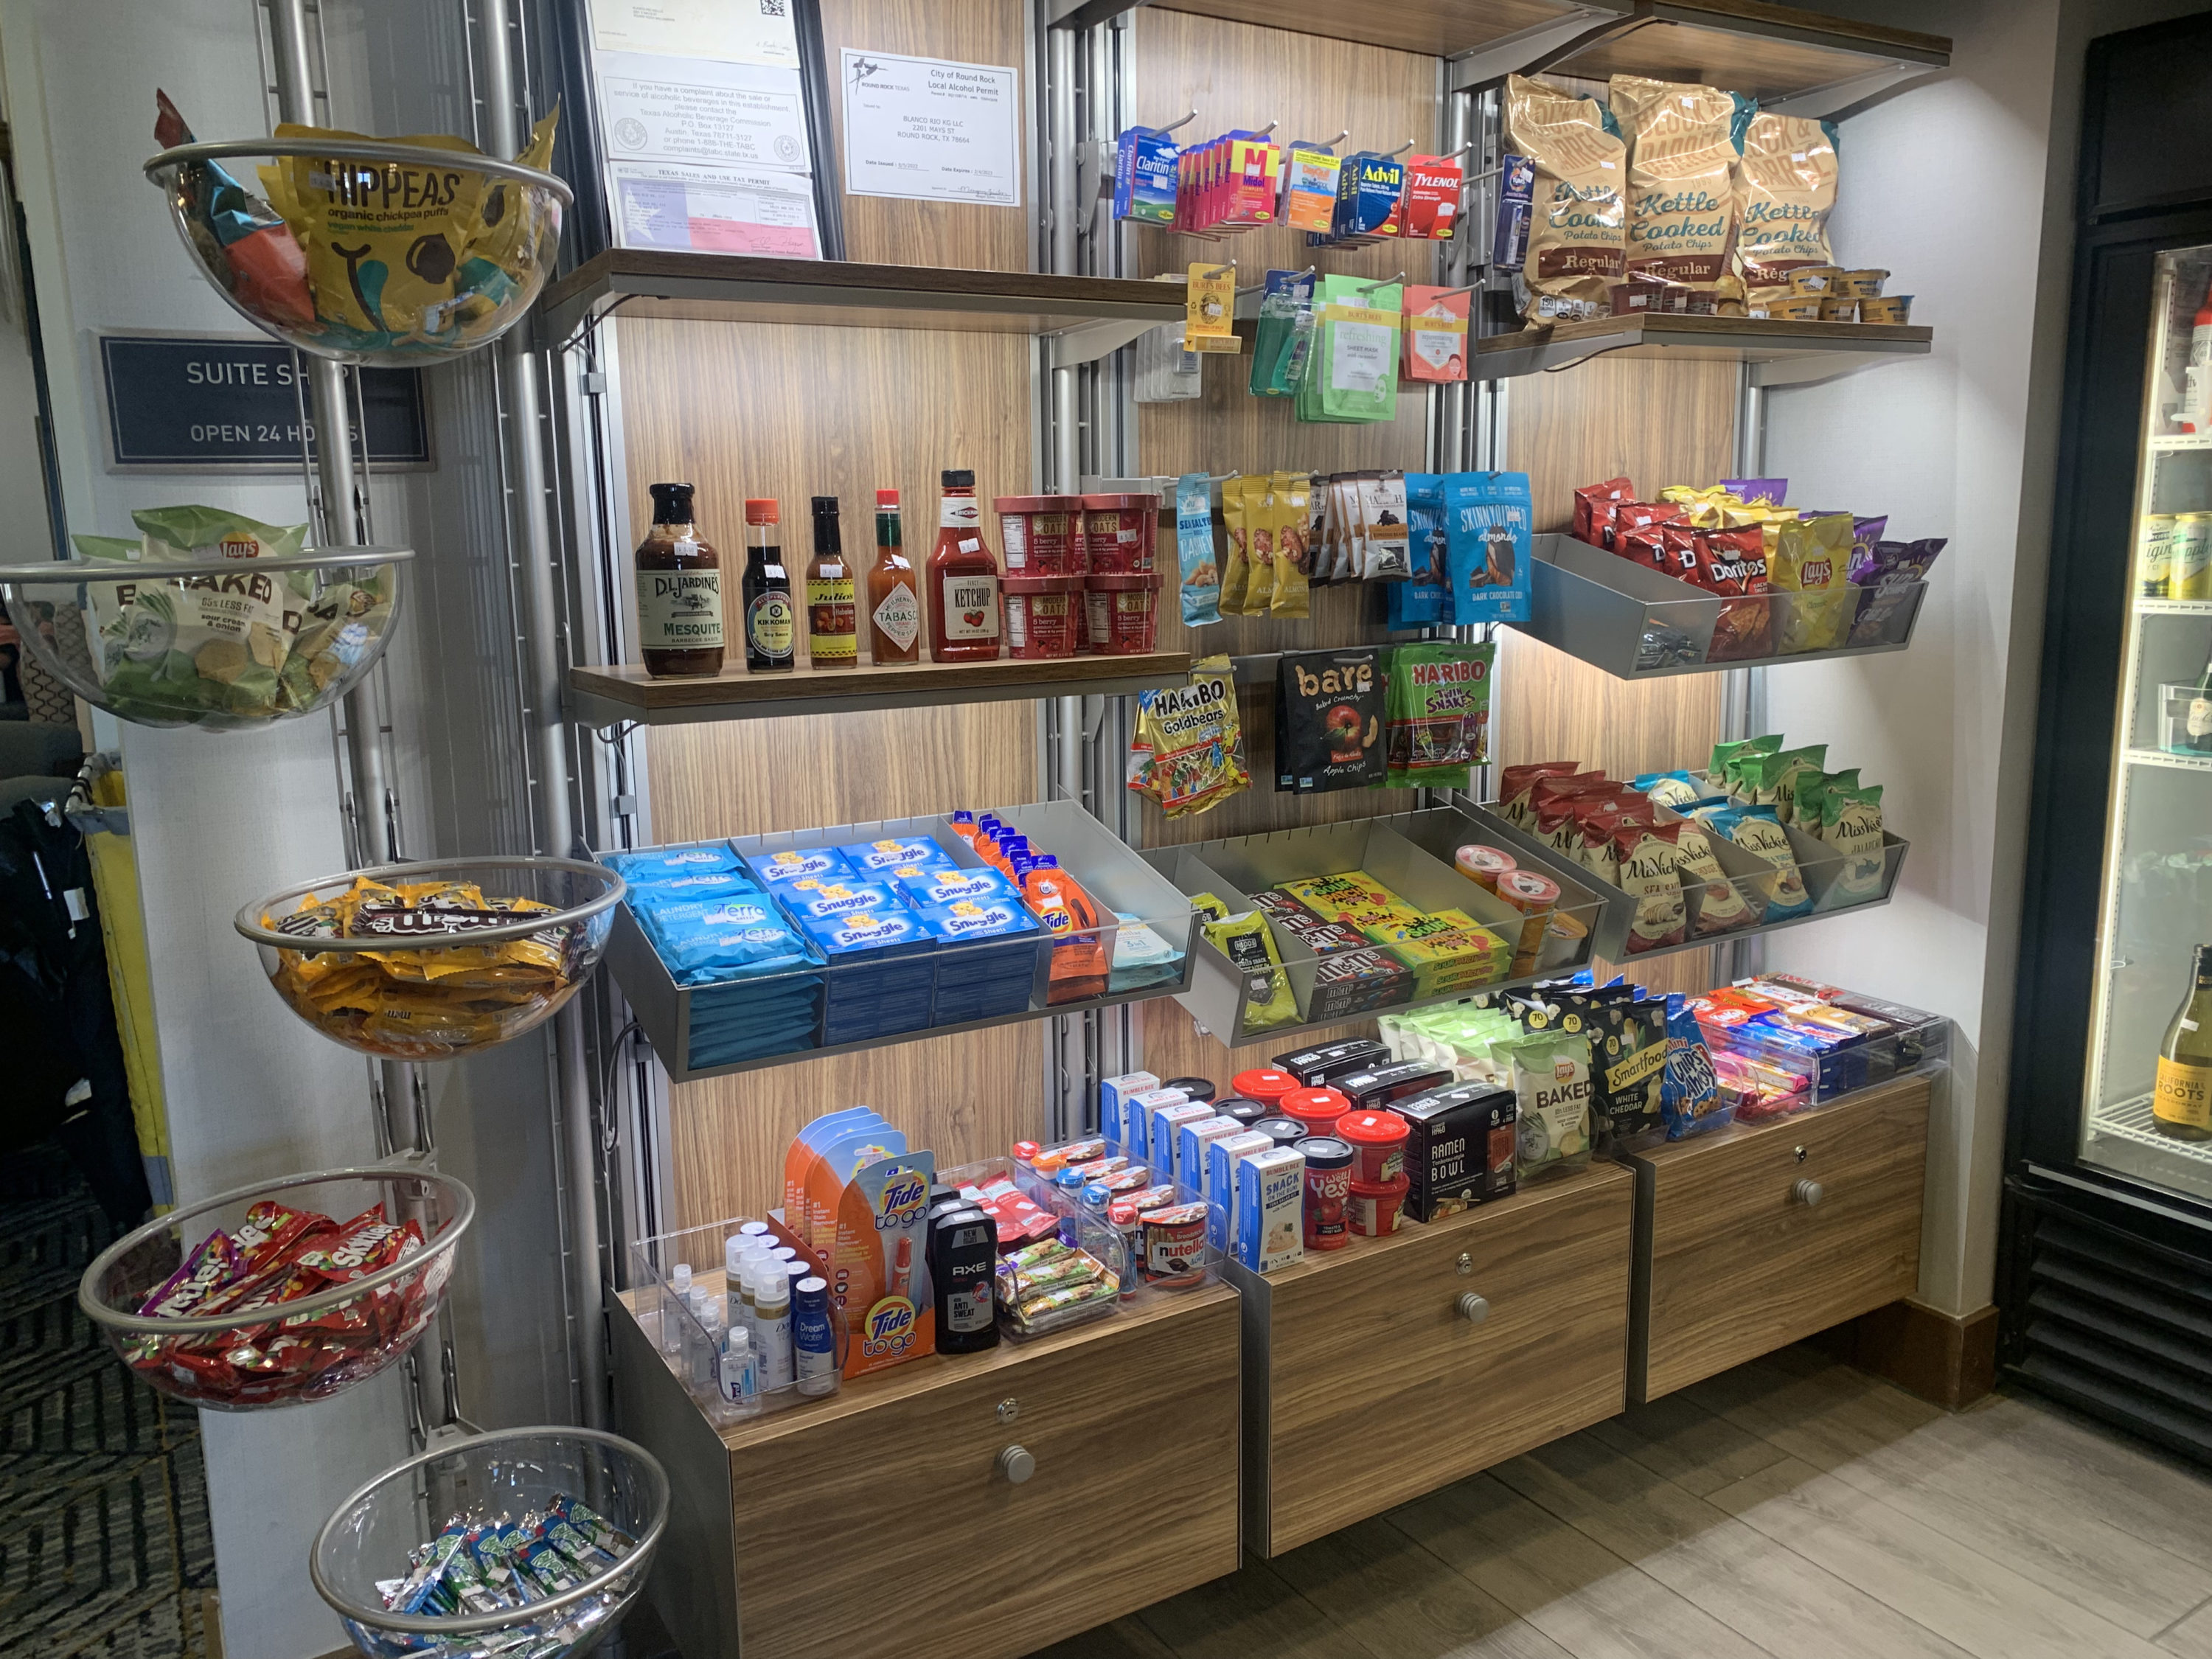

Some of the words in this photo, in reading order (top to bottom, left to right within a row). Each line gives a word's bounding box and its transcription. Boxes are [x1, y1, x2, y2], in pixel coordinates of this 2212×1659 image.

[931, 69, 945, 79] City
[956, 72, 978, 82] Round
[979, 75, 995, 84] Rock
[680, 87, 713, 97] complaint
[715, 90, 734, 98] about
[928, 80, 947, 91] Local
[949, 83, 975, 93] Alcohol
[976, 86, 999, 96] Permit
[650, 94, 681, 102] alcoholic
[683, 95, 720, 105] beverages
[674, 103, 698, 111] please
[699, 105, 724, 114] contact
[640, 108, 661, 116] Texas
[663, 111, 694, 119] Alcoholic
[696, 113, 728, 123] Beverage
[730, 116, 771, 127] Commission
[903, 115, 928, 124] BLANCO
[929, 117, 941, 125] RIO
[692, 130, 711, 138] Texas
[698, 122, 712, 130] Box
[912, 124, 928, 132] 2201
[929, 126, 945, 134] MAYS
[897, 131, 919, 139] ROUND
[922, 133, 940, 142] ROCK,
[951, 136, 970, 144] 78664
[1126, 144, 1134, 175] Claritin
[1136, 156, 1169, 175] Claritin
[1243, 175, 1264, 187] Midol
[1362, 164, 1399, 184] Advil
[1415, 173, 1459, 188] TYLENOL
[324, 160, 460, 209] HIPPEAS
[1635, 192, 1719, 217] Kettle
[328, 209, 375, 221] organic
[375, 210, 422, 221] chickpea
[423, 207, 448, 220] puffs
[1630, 217, 1725, 242] Cooked
[1643, 240, 1683, 252] Potato
[1684, 238, 1712, 251] Chips
[1644, 262, 1711, 279] Regular
[1339, 328, 1386, 347] refreshing
[187, 362, 268, 385] SUITE
[190, 425, 251, 442] OPEN
[257, 425, 281, 442] 24
[288, 425, 358, 442] HOS
[1460, 504, 1528, 532] SKINNYDIPPED
[1478, 527, 1518, 543] almonds
[1710, 556, 1767, 582] Doritos
[815, 593, 853, 601] Julio's
[954, 588, 991, 608] KETCHUP
[1043, 597, 1066, 605] MODERN
[1472, 592, 1487, 601] DARK
[1043, 605, 1066, 615] OATS
[1128, 601, 1149, 611] OATS
[664, 622, 720, 636] MESQUITE
[1295, 663, 1374, 698] bare
[1413, 659, 1486, 686] HARIBO
[1153, 679, 1225, 719] HARIBO
[1434, 686, 1463, 700] TWIN
[1315, 698, 1332, 711] Baked
[1333, 693, 1363, 706] Crunchy
[1425, 690, 1477, 714] SNAKES
[1163, 709, 1224, 735] Goldbears
[1324, 764, 1345, 776] Apple
[1346, 760, 1367, 773] Chips
[935, 880, 992, 900] Snuggle
[1312, 879, 1354, 895] SOUR
[1321, 886, 1368, 902] PATCH
[652, 902, 704, 916] LAUNDRY
[713, 902, 765, 918] Terra
[816, 894, 877, 913] Snuggle
[949, 911, 1008, 933] Snuggle
[1042, 911, 1069, 928] Tide
[1406, 920, 1453, 939] SOUR
[1531, 1014, 1543, 1025] 70
[1613, 1044, 1668, 1087] Smartfood
[1536, 1080, 1592, 1109] BAKED
[1615, 1093, 1638, 1105] WHITE
[2157, 1082, 2204, 1100] ROOTS
[1610, 1101, 1643, 1115] CHEDDAR
[1431, 1137, 1465, 1161] RAMEN
[1266, 1165, 1290, 1177] BUMBLE
[1290, 1161, 1299, 1169] BEE
[1431, 1160, 1464, 1182] BOWL
[1265, 1172, 1299, 1196] SNACK
[886, 1181, 925, 1215] Tide
[874, 1213, 898, 1231] to
[901, 1206, 928, 1229] go
[963, 1229, 977, 1238] NEW
[1160, 1239, 1204, 1257] nutella
[953, 1262, 987, 1276] AXE
[953, 1307, 975, 1318] SWEAT
[954, 1301, 969, 1310] ANTI
[799, 1322, 825, 1333] Dream
[872, 1307, 913, 1340] Tide
[799, 1330, 824, 1342] Water
[863, 1337, 890, 1358] to
[891, 1331, 916, 1356] go
